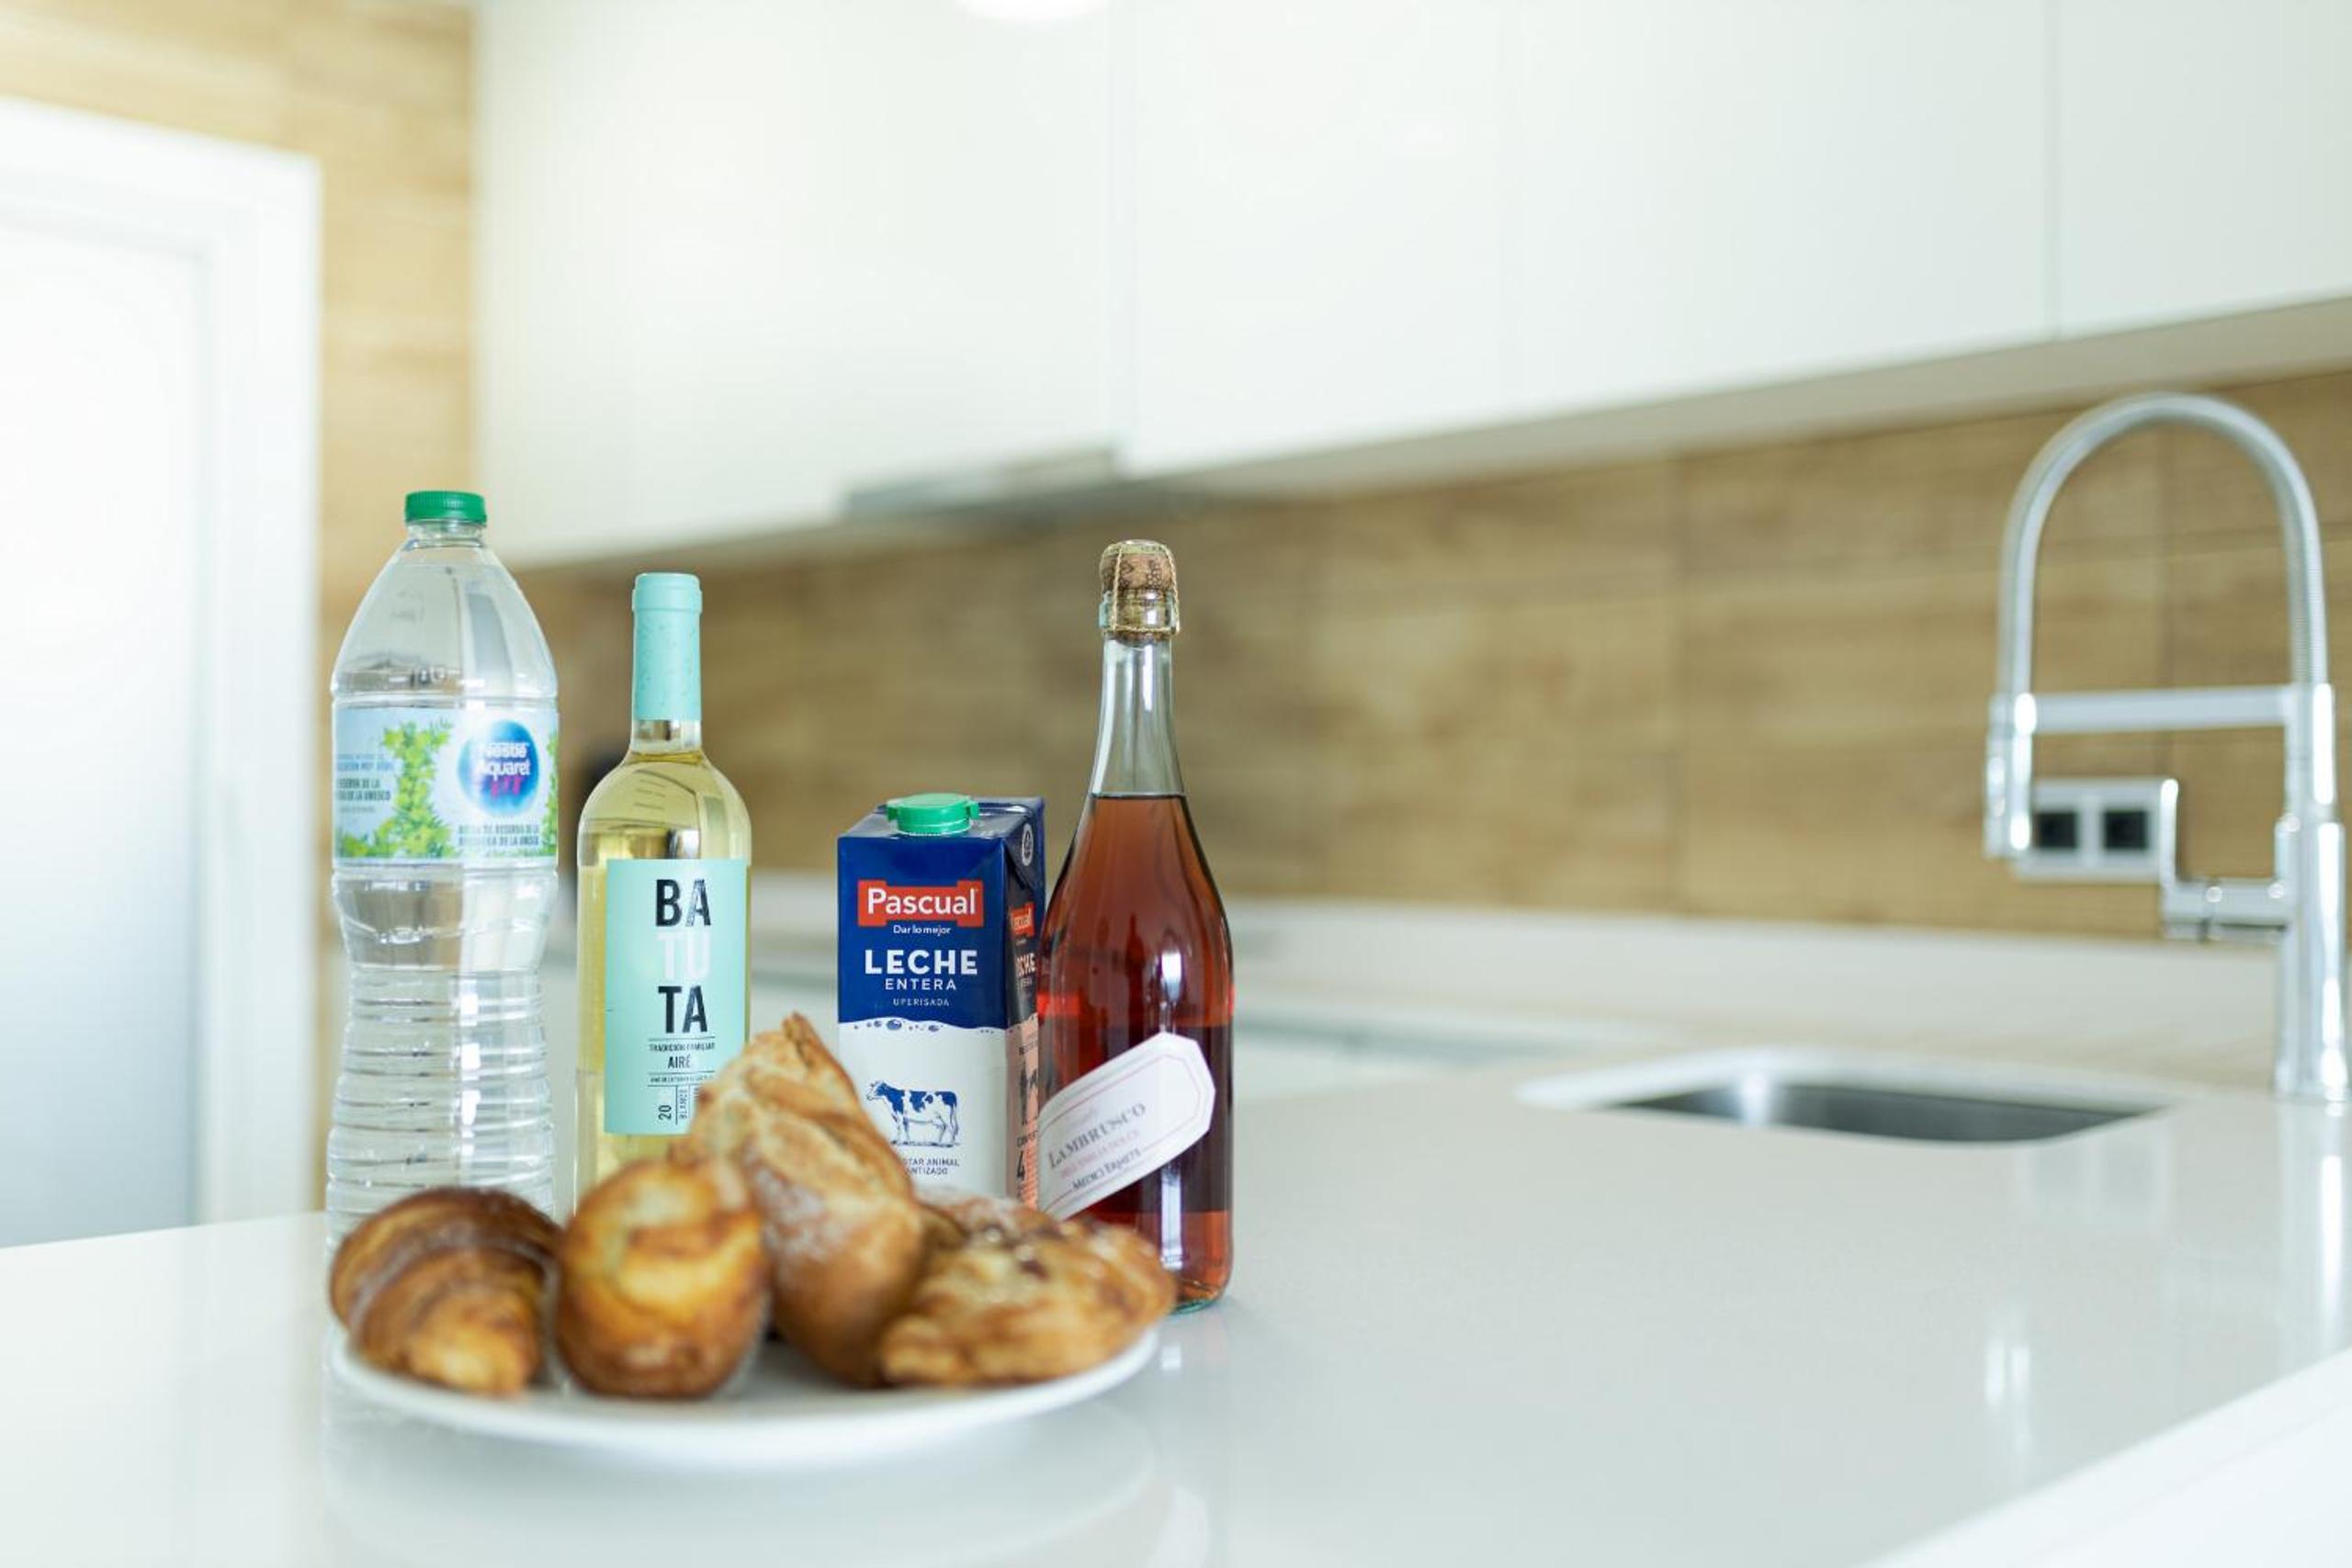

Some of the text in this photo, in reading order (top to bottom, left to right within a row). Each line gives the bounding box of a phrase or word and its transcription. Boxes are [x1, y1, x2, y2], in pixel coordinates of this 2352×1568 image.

[656, 879, 711, 927] BA
[867, 887, 977, 914] Pascual
[893, 924, 911, 934] Dar
[923, 924, 951, 937] mejor
[656, 931, 711, 980] TU
[865, 949, 978, 976] LECHE
[885, 977, 957, 991] ENTERA
[658, 986, 707, 1033] TA
[658, 1104, 673, 1121] 20
[1048, 1102, 1146, 1170] LAMBRUSCO
